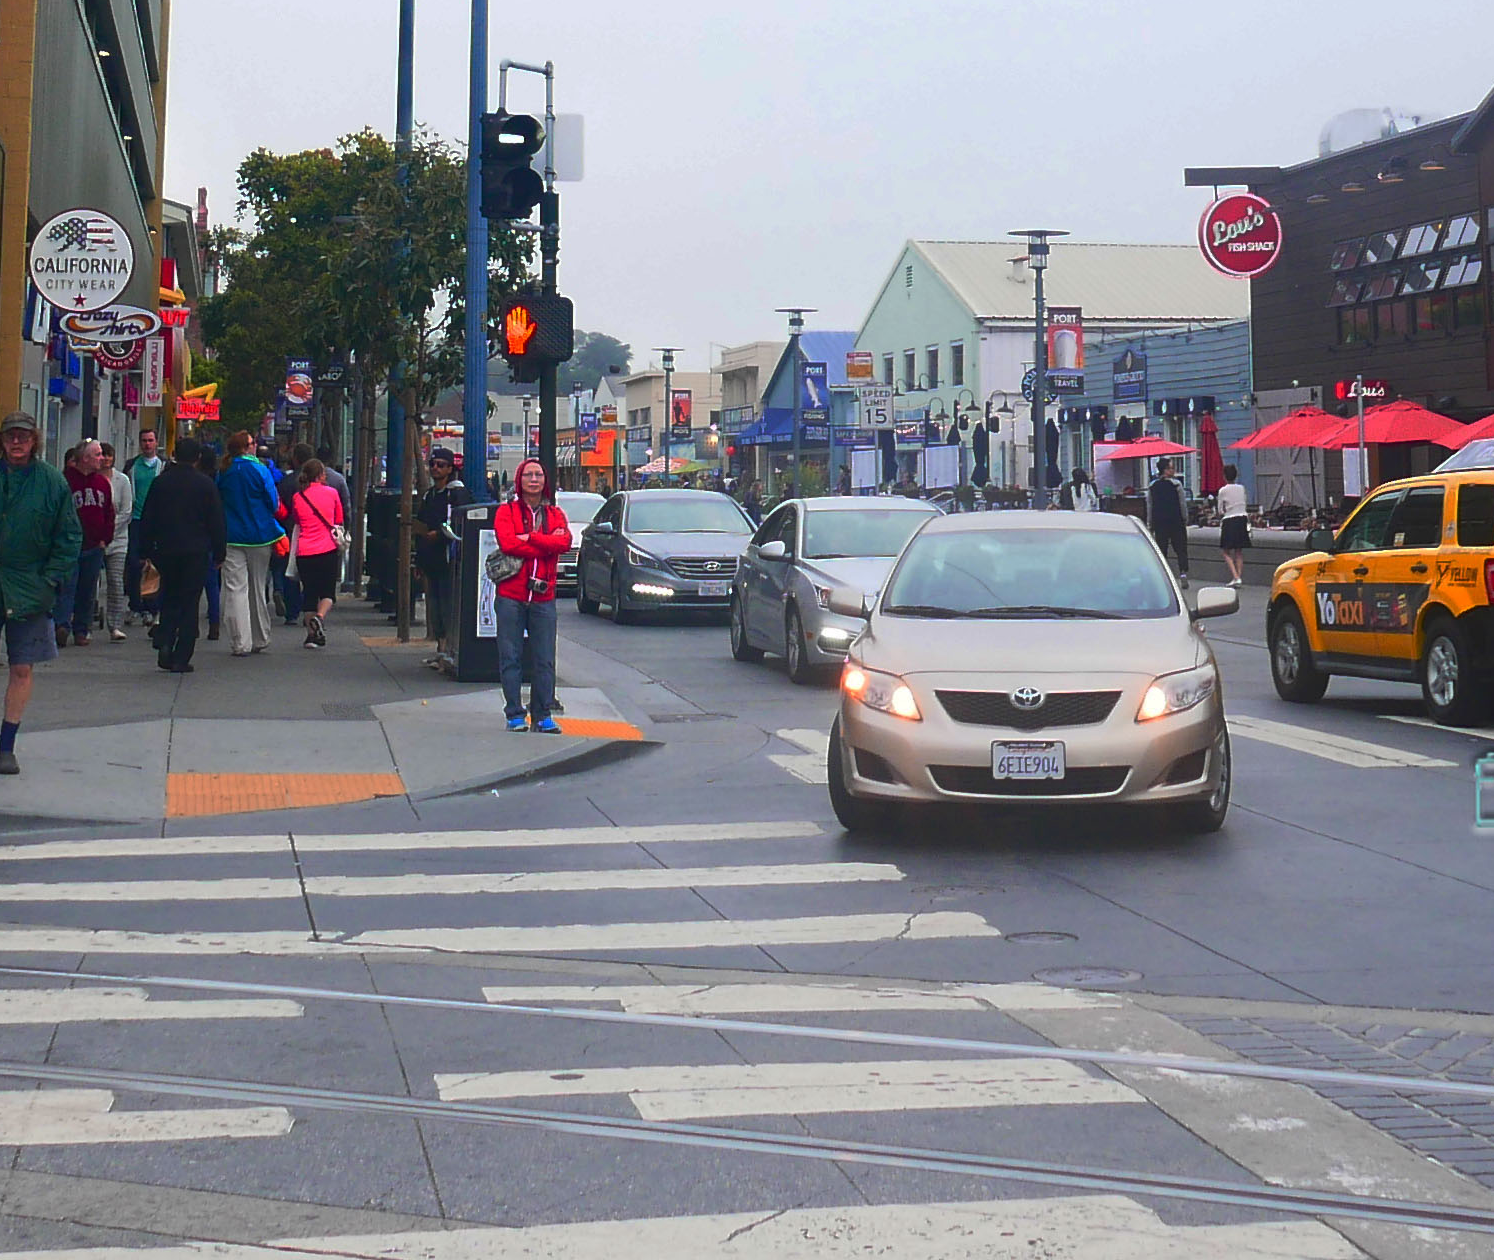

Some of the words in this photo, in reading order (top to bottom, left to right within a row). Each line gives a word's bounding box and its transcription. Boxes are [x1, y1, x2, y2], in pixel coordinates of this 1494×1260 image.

[1212, 205, 1264, 247] Lou's
[33, 257, 129, 275] CALIFORNIA
[45, 279, 75, 290] CITY
[78, 280, 117, 291] WEAR
[1053, 314, 1077, 324] PORT
[862, 390, 891, 398] SPEED
[864, 399, 887, 407] LIMIT
[865, 408, 888, 425] 15
[73, 487, 105, 508] GAP
[1316, 592, 1365, 626] YoTaxi
